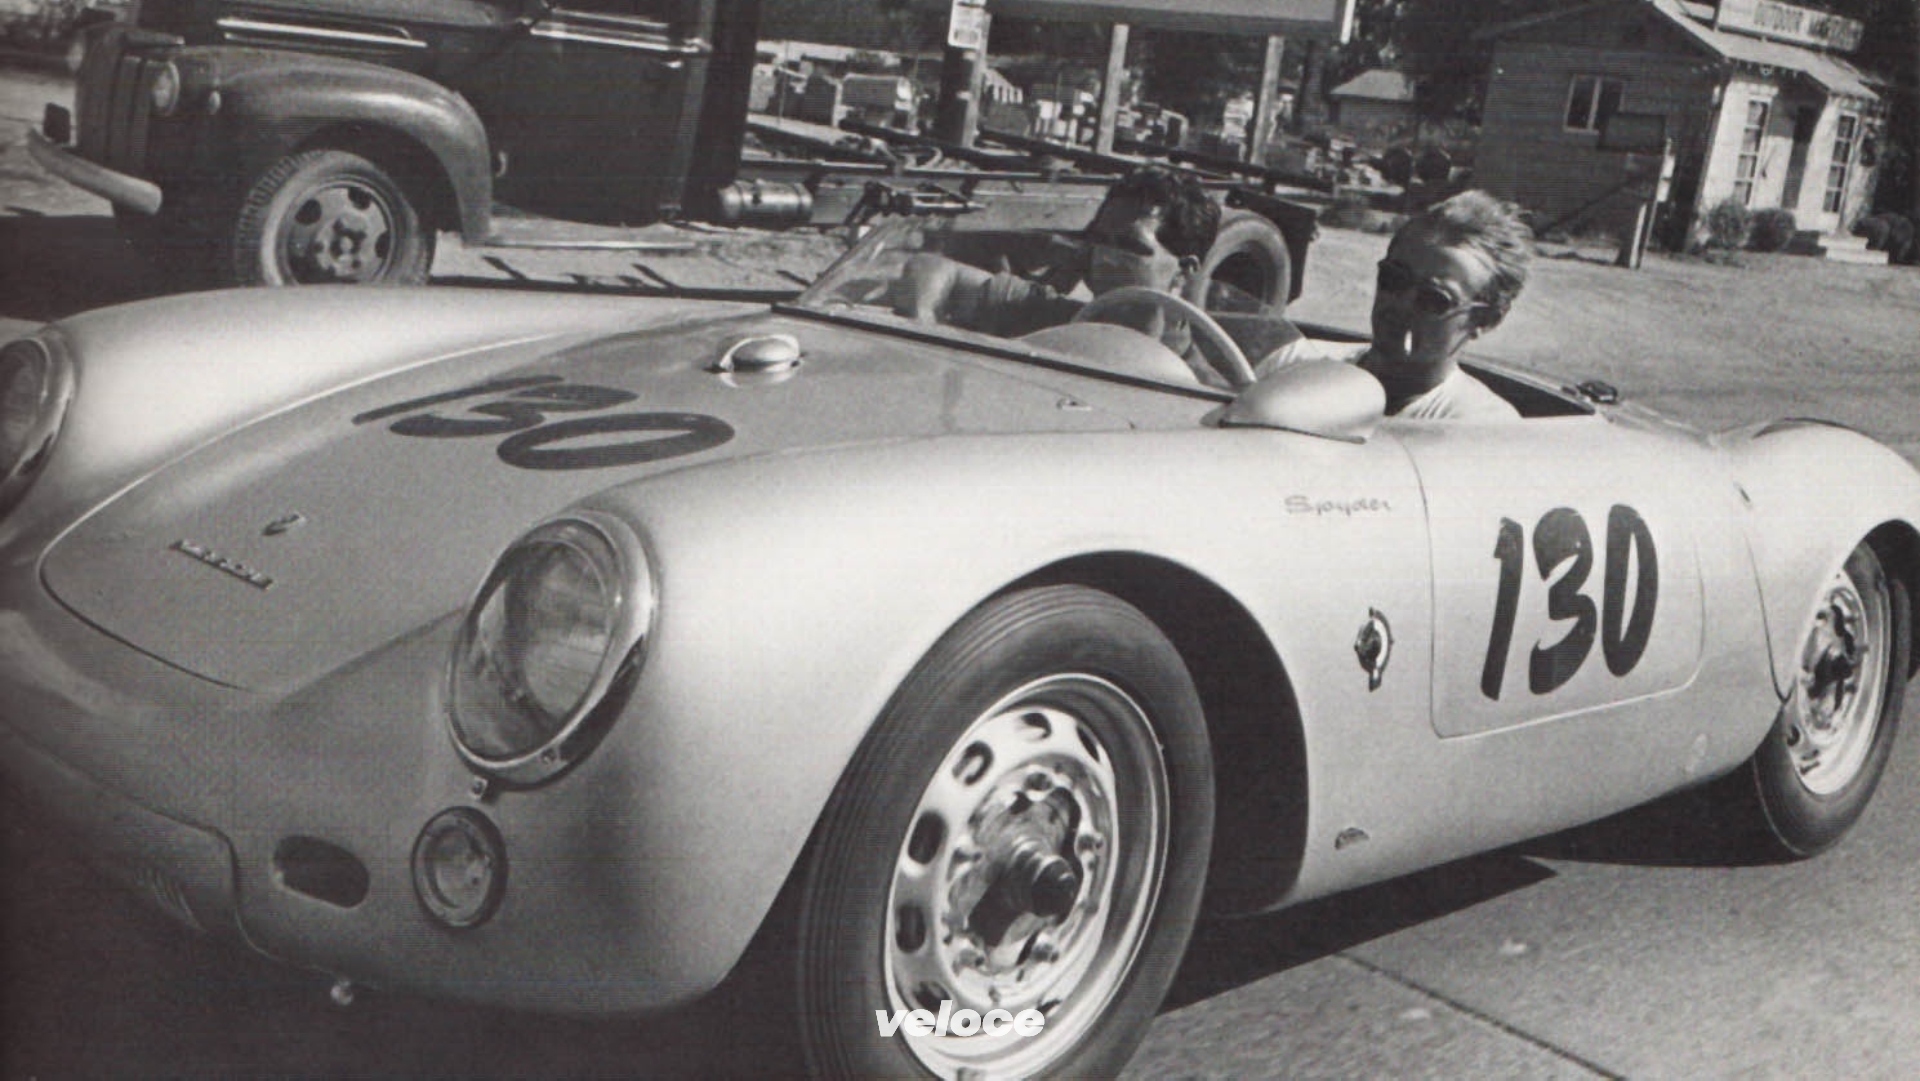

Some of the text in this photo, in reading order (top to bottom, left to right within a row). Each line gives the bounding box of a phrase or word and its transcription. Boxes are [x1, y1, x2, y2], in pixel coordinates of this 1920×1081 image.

[351, 374, 735, 470] 130
[1284, 494, 1392, 517] Spyder
[1480, 503, 1658, 701] 130
